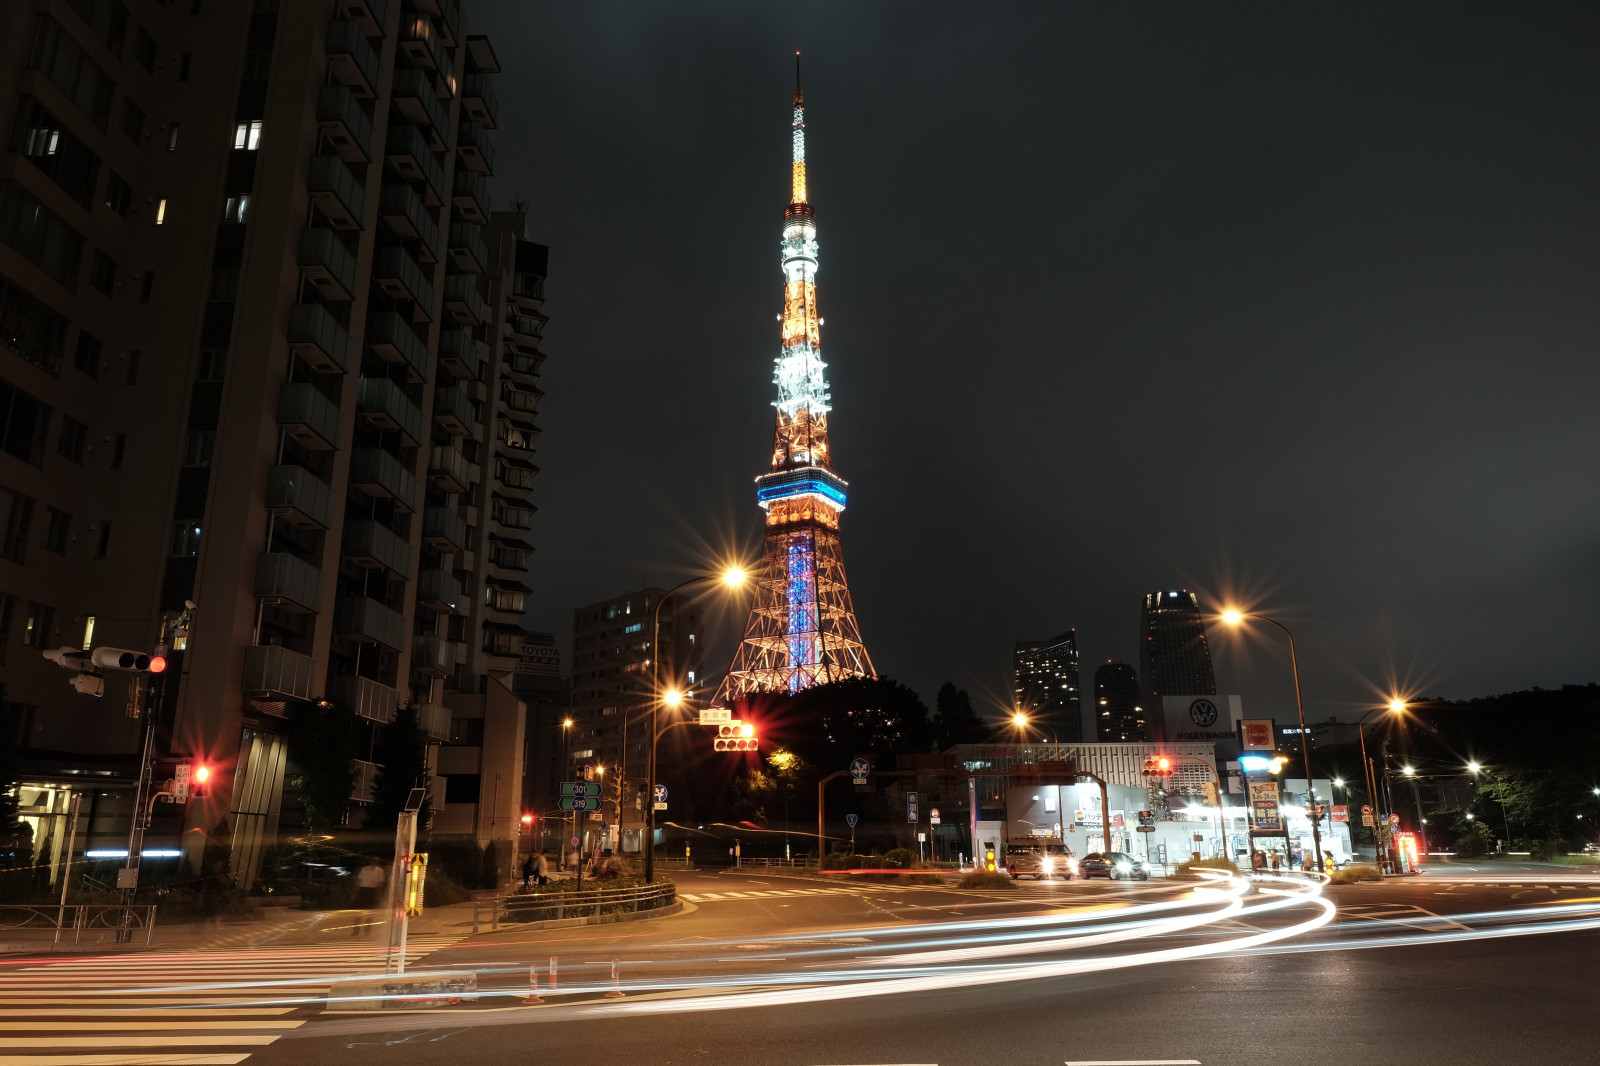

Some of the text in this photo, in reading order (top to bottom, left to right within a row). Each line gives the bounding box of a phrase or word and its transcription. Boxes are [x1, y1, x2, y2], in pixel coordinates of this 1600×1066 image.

[521, 646, 560, 656] TOYOTA
[1177, 732, 1236, 740] VOLKSWAGEN
[574, 785, 586, 794] 301
[573, 800, 586, 808] 319
[1257, 808, 1276, 817] 給油
